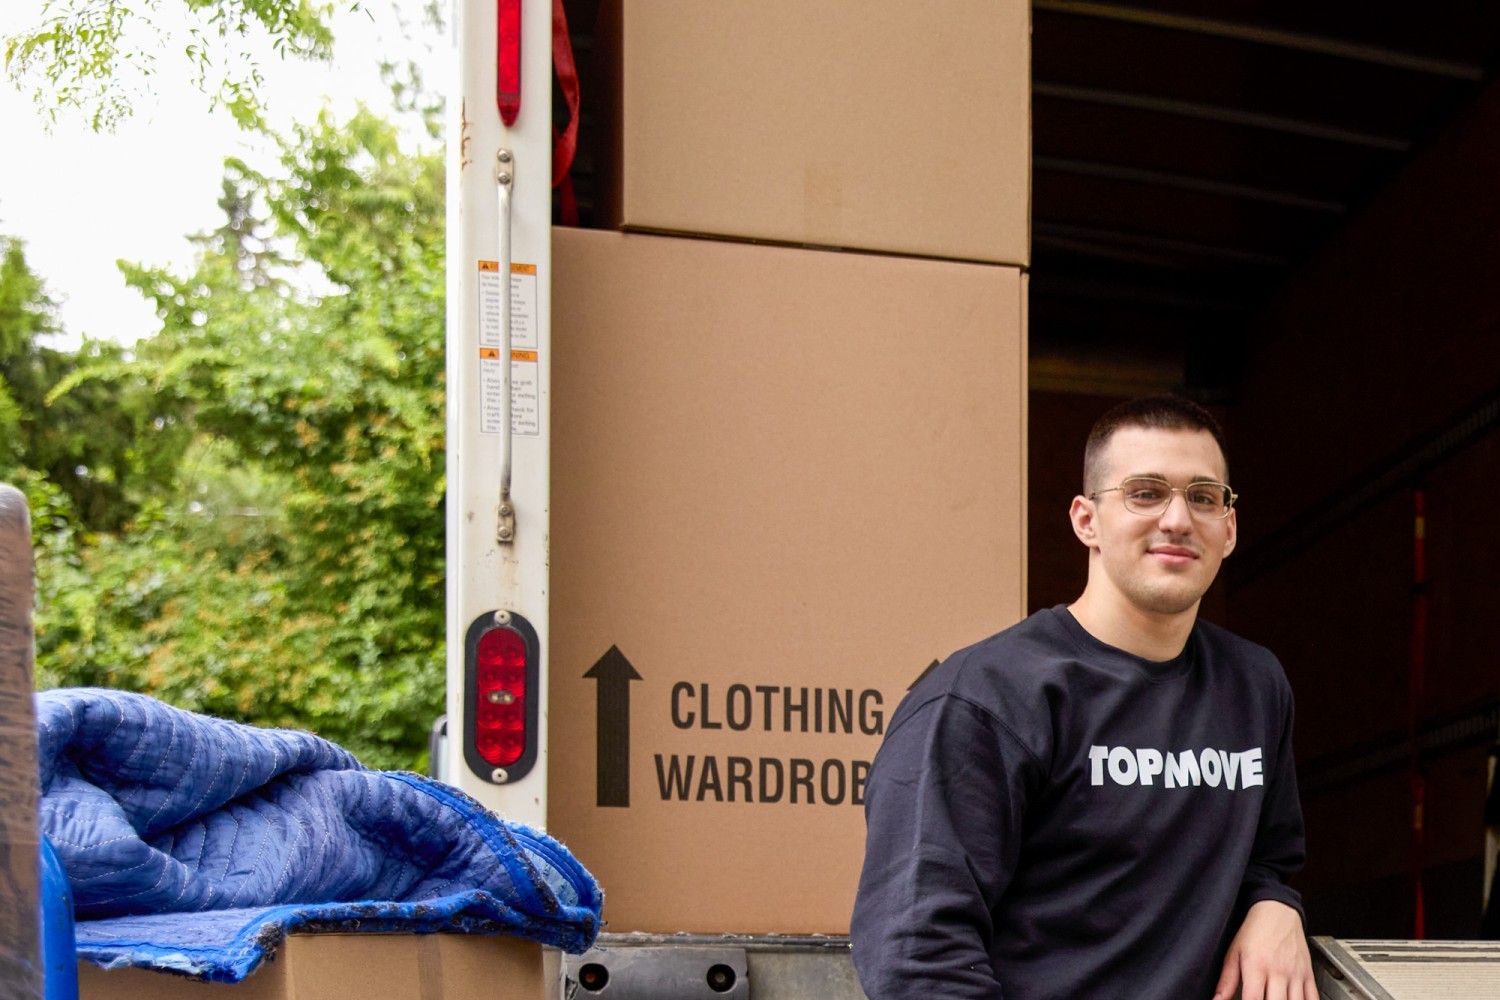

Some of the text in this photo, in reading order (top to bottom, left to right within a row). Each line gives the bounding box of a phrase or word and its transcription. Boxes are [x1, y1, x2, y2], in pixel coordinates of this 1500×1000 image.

[671, 681, 883, 735] CLOTHING
[1088, 745, 1264, 791] TOP MOVE
